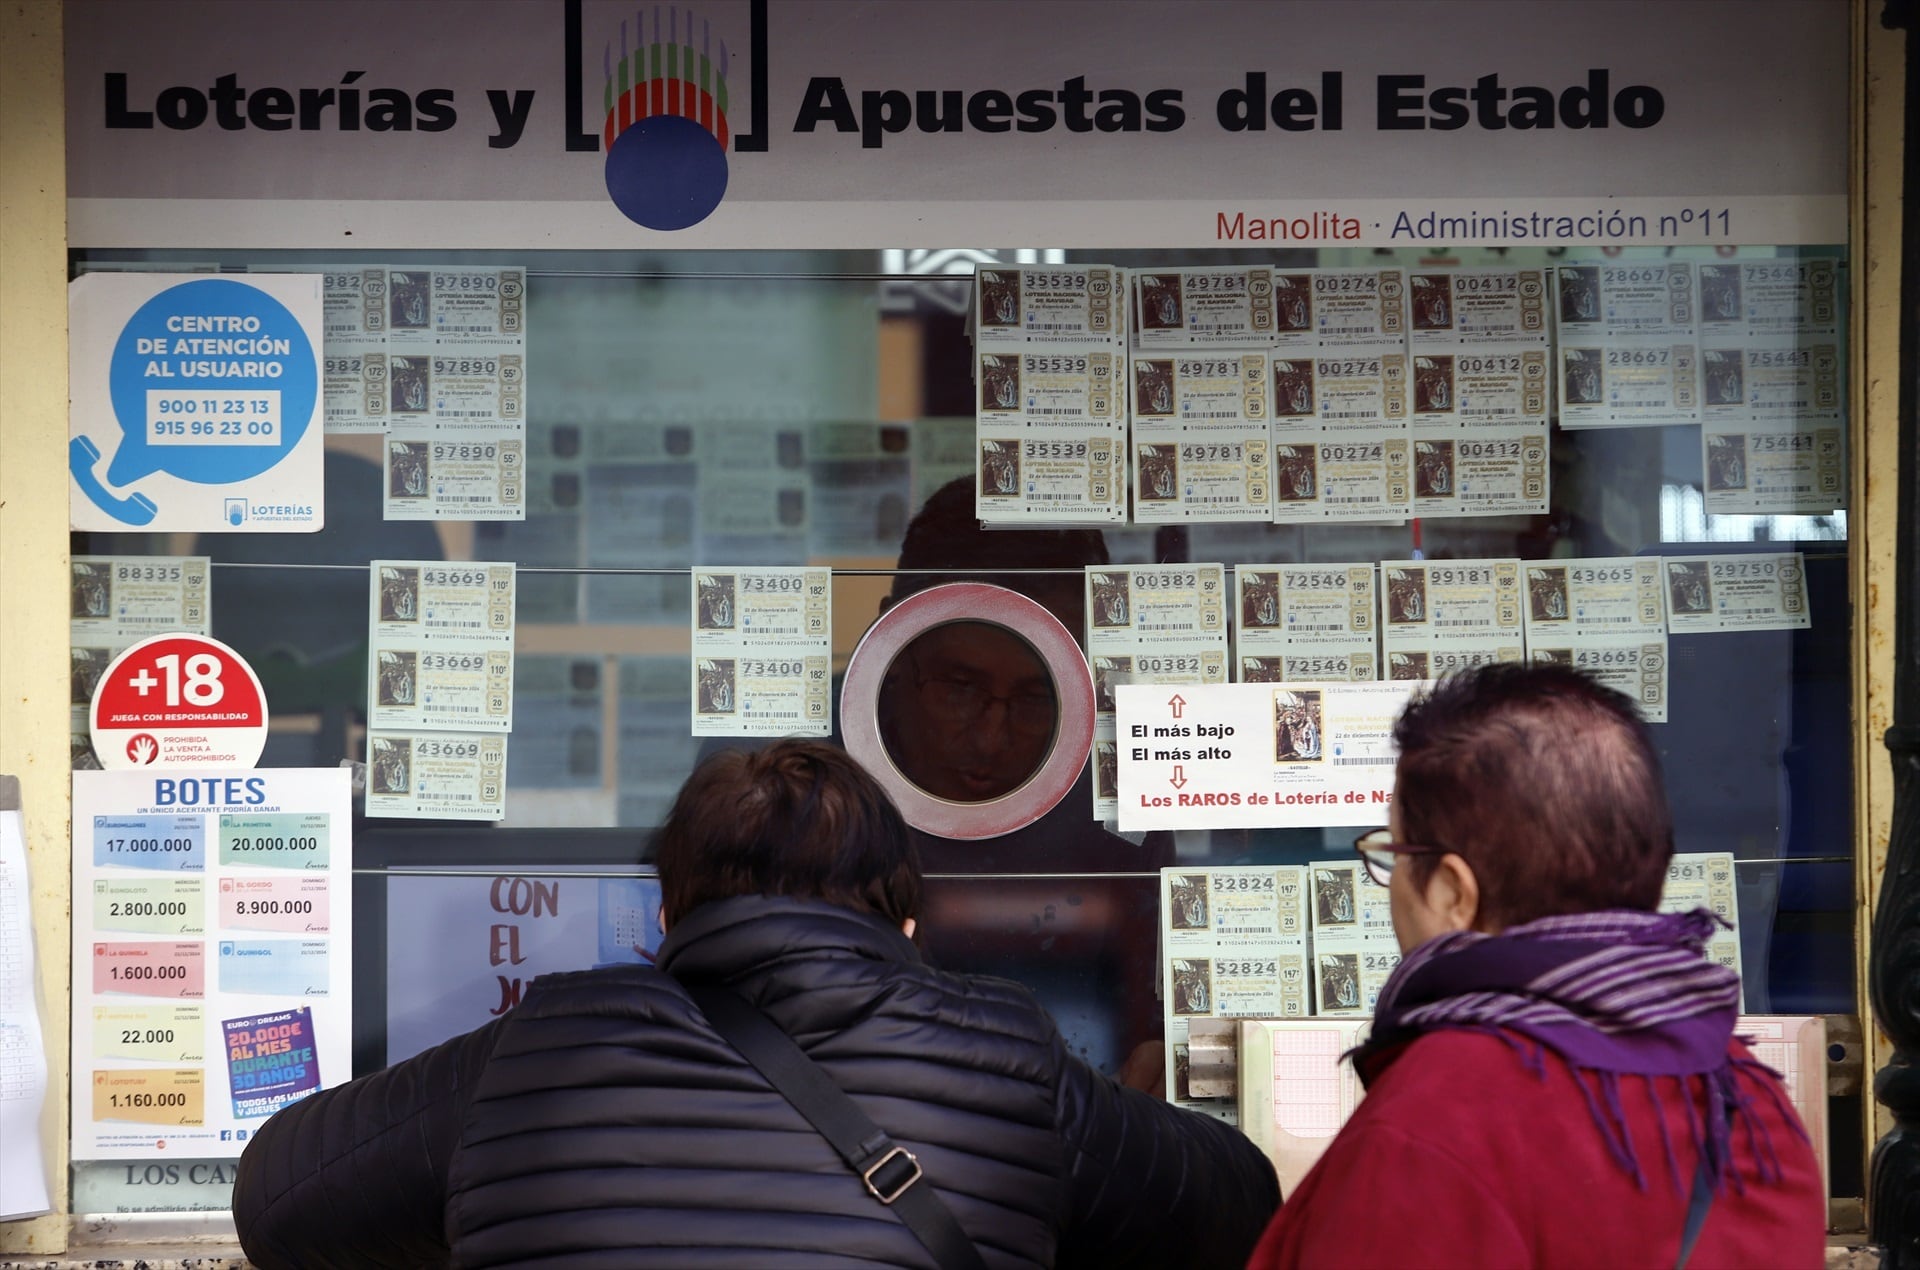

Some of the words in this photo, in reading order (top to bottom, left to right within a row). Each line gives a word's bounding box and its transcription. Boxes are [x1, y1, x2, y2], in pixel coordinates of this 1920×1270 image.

[104, 71, 457, 131] Loterías
[487, 89, 535, 148] y
[794, 76, 1186, 148] Apuestas
[1216, 72, 1343, 131] del
[1376, 69, 1665, 130] Estado
[1217, 211, 1362, 240] Manolita
[1391, 208, 1647, 240] Administración
[1026, 275, 1086, 287] 35539
[1604, 268, 1665, 282] 28667
[434, 276, 496, 289] 97890
[1186, 276, 1246, 290] 49781
[1316, 278, 1376, 291] 00274
[1456, 278, 1517, 290] 00412
[167, 316, 260, 333] CENTRO
[137, 339, 167, 355] DE
[173, 335, 290, 355] ATENCIÓN
[1608, 350, 1669, 364] 28667
[144, 362, 174, 377] AL
[181, 362, 283, 377] USUARIO
[434, 360, 496, 373] 97890
[1026, 359, 1086, 371] 35539
[1180, 362, 1240, 375] 49781
[1318, 362, 1379, 375] 00274
[1459, 359, 1520, 372] 00412
[160, 401, 196, 413] 900
[203, 401, 217, 413] 11
[223, 401, 245, 413] 23
[252, 401, 268, 413] 13
[155, 421, 185, 435] 915
[191, 421, 214, 435] 96
[220, 421, 242, 435] 23
[248, 421, 273, 435] 00
[1460, 443, 1520, 456] 00412
[1752, 436, 1812, 449] 75441
[434, 446, 496, 458] 97890
[1026, 444, 1086, 456] 35539
[1182, 446, 1242, 459] 49781
[1321, 447, 1382, 460] 00274
[252, 504, 312, 515] LOTERÍAS
[118, 567, 180, 580] 88335
[1572, 568, 1633, 582] 43665
[1714, 563, 1774, 576] 29750
[424, 572, 485, 584] 43669
[742, 578, 802, 590] 73400
[1135, 574, 1196, 588] 00382
[1286, 574, 1346, 588] 72546
[1431, 570, 1491, 584] 99181
[422, 656, 483, 668] 43669
[1577, 650, 1638, 664] 43665
[742, 662, 802, 674] 73400
[1138, 658, 1199, 672] 00382
[1287, 659, 1348, 672] 72546
[129, 654, 224, 706] +18
[1131, 725, 1147, 737] El
[1154, 724, 1190, 737] más
[1197, 724, 1234, 739] bajo
[417, 743, 478, 756] 43669
[1132, 749, 1148, 760] El
[1155, 748, 1191, 761] más
[1198, 747, 1231, 760] alto
[155, 778, 265, 805] BOTES
[1141, 795, 1172, 807] Los
[1178, 793, 1241, 806] RAROS
[1248, 792, 1268, 805] de
[1275, 791, 1337, 804] Lotería
[1344, 791, 1365, 804] de
[107, 839, 192, 852] 17.000.000
[232, 837, 317, 851] 20.000.000
[1214, 878, 1274, 890] 52824
[490, 876, 558, 918] CON
[110, 902, 186, 916] 2.800.000
[237, 901, 312, 914] 8.900.000
[490, 924, 527, 966] EL
[111, 966, 186, 980] 1.600.000
[1216, 962, 1277, 975] 52824
[227, 1020, 249, 1029] EURO
[257, 1014, 291, 1025] DREAMS
[122, 1030, 174, 1044] 22.000
[229, 1022, 302, 1046] 20.000€
[230, 1047, 254, 1061] AL
[257, 1038, 291, 1056] MES
[232, 1047, 312, 1075] DURANTE
[233, 1074, 256, 1089] 30
[260, 1063, 306, 1085] AÑOS
[111, 1094, 186, 1107] 1.160.000
[237, 1097, 266, 1108] TODOS
[268, 1094, 285, 1104] LOS
[287, 1087, 317, 1102] LUNES
[237, 1108, 245, 1116] Y
[245, 1104, 281, 1114] JUEVES
[126, 1164, 180, 1186] LOS
